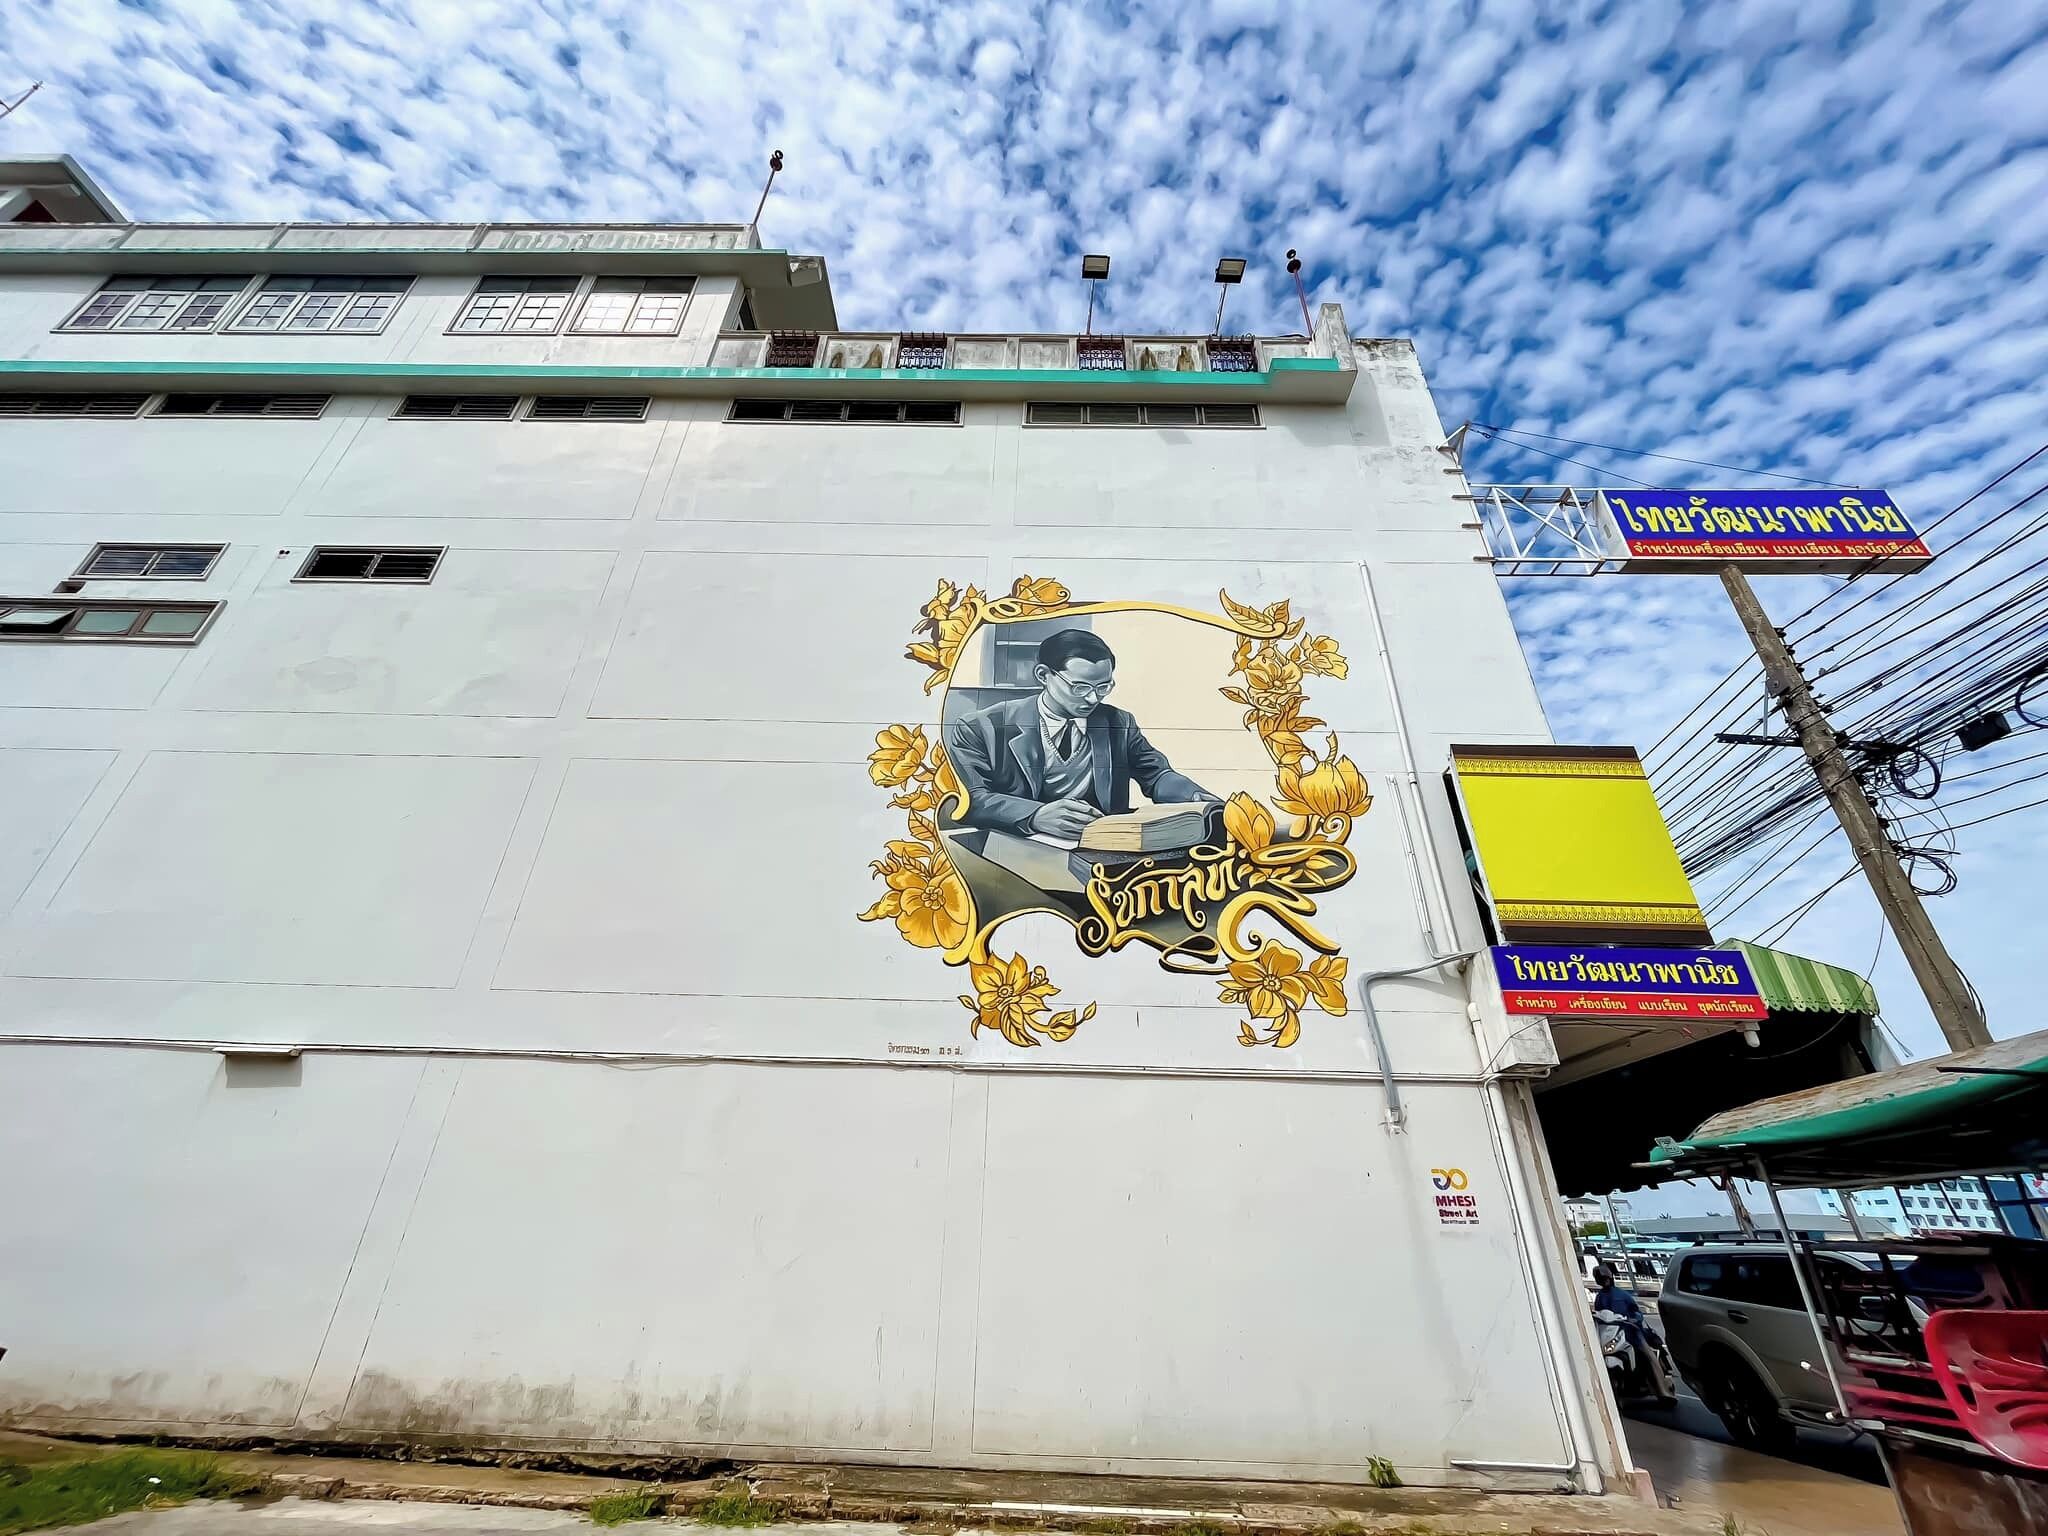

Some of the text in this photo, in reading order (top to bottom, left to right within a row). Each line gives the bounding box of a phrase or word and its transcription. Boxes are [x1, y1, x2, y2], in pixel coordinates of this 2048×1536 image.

[1610, 495, 1907, 533] ไทยวัฒนาพานิช
[1505, 954, 1739, 985] ไทยวัฒนาพานิช
[1516, 995, 1755, 1015] จำหน่าย เครื่องเขียน แบบเรียน ชุดนักเรียน
[1435, 1195, 1477, 1207] MHESI
